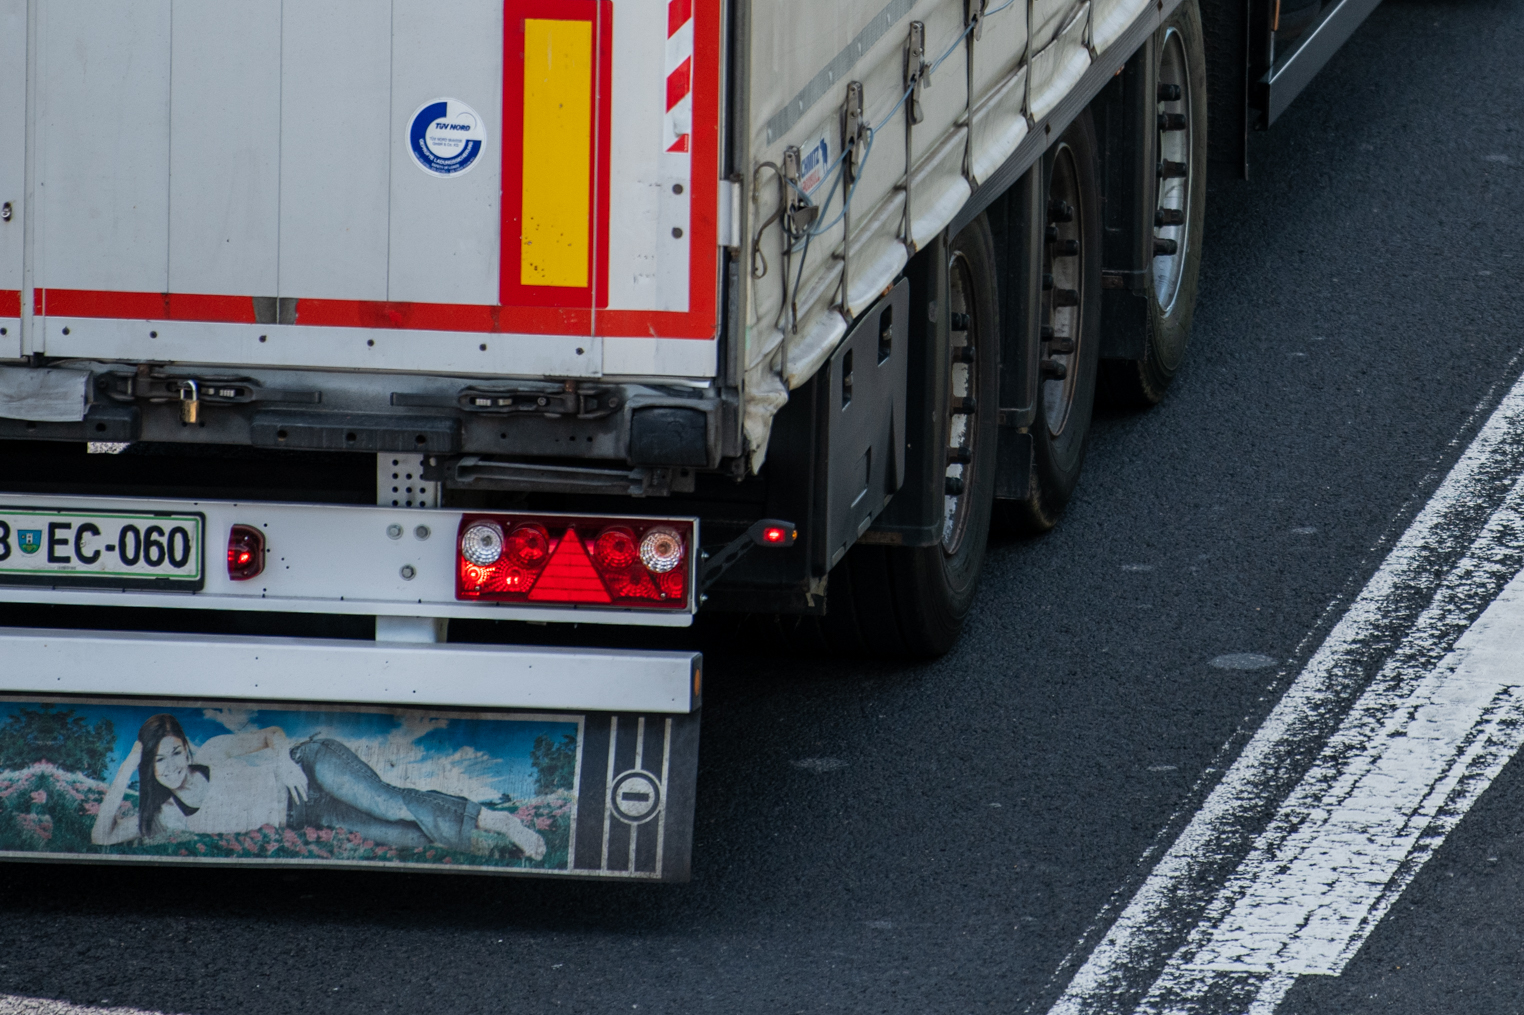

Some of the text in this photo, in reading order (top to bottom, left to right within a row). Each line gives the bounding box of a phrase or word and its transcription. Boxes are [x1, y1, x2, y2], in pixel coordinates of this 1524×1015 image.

[435, 122, 471, 132] TÜV NORD
[47, 522, 190, 569] EC-060
